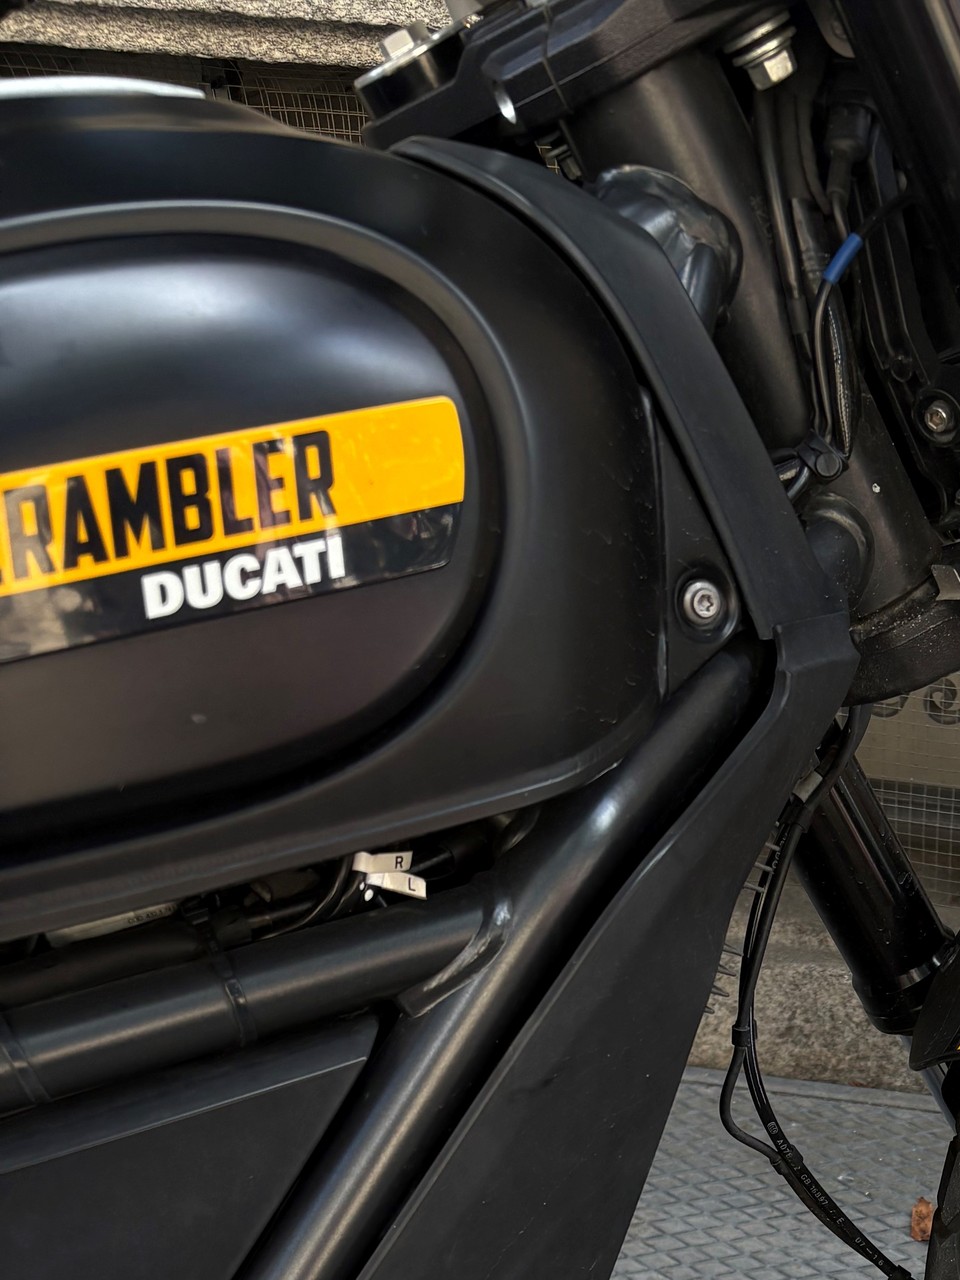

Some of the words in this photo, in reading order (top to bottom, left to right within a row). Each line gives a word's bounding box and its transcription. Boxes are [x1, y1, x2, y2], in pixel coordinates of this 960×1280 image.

[0, 430, 337, 586] RAMBLER
[141, 535, 346, 619] DUCATI
[394, 855, 404, 869] R
[408, 877, 416, 892] L
